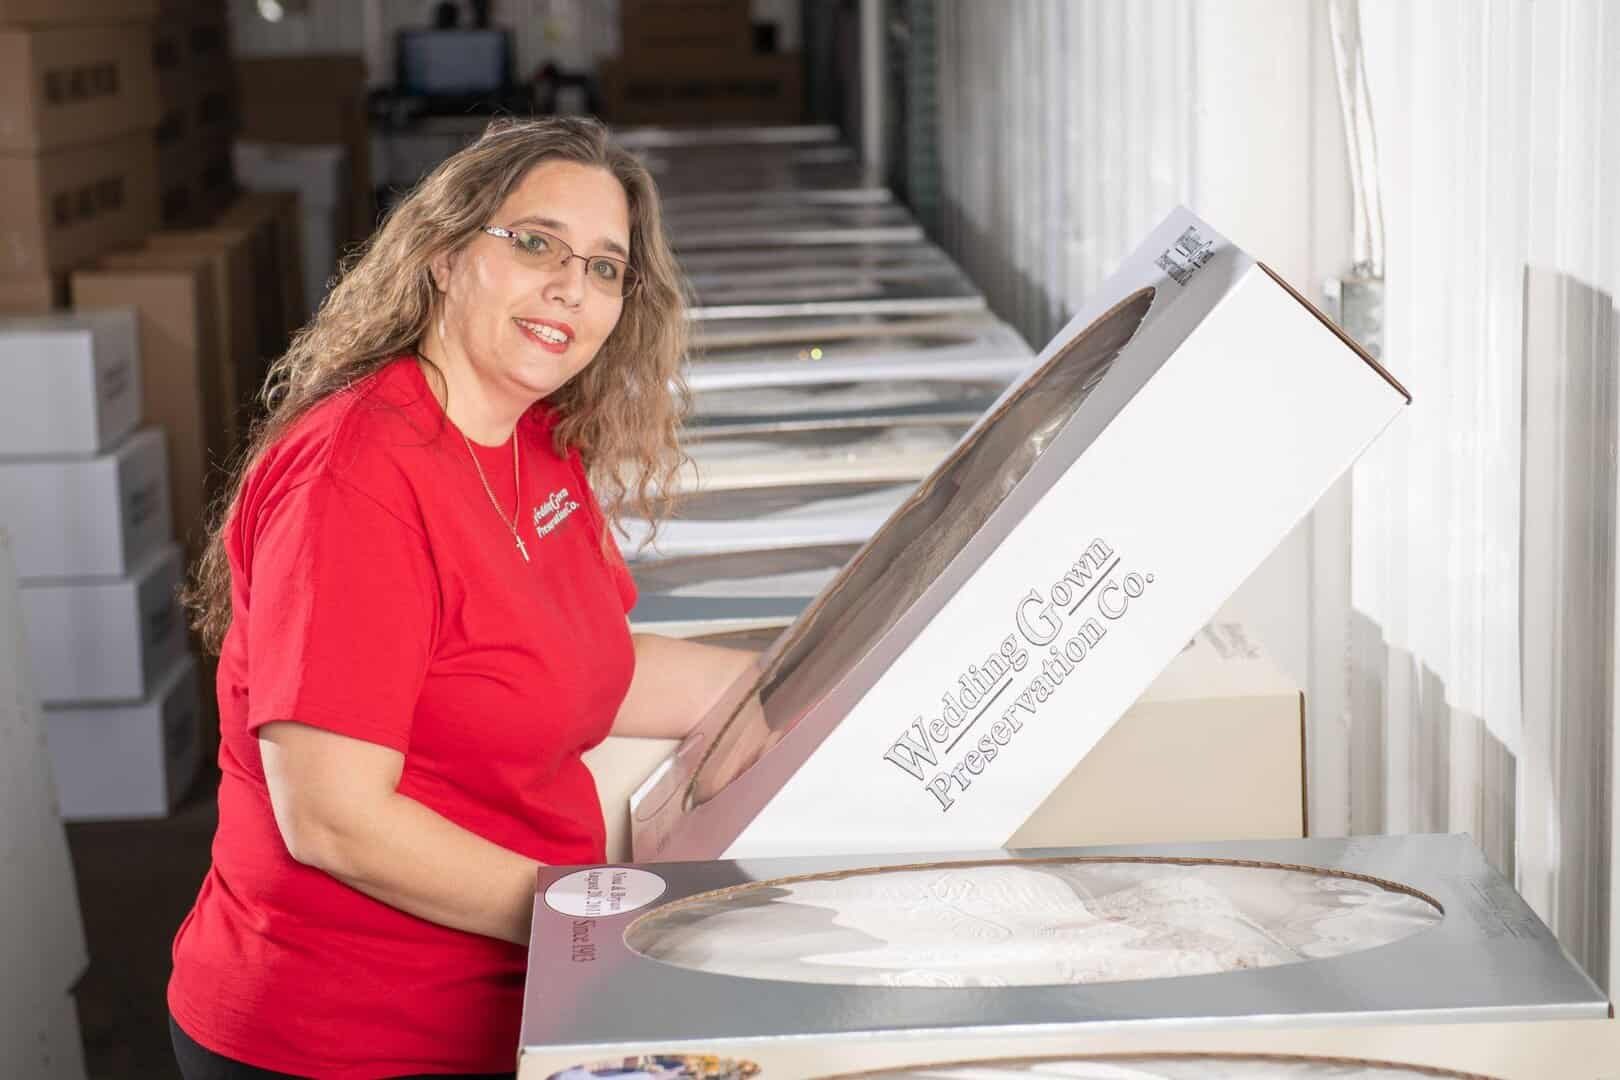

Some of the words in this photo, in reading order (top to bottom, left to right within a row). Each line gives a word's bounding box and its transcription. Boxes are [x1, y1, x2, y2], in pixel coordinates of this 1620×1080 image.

[883, 633, 1029, 781] Wedding
[1016, 537, 1115, 647] Gown
[925, 616, 1107, 812] Preservation
[1097, 571, 1155, 620] Co.
[572, 919, 596, 942] Since
